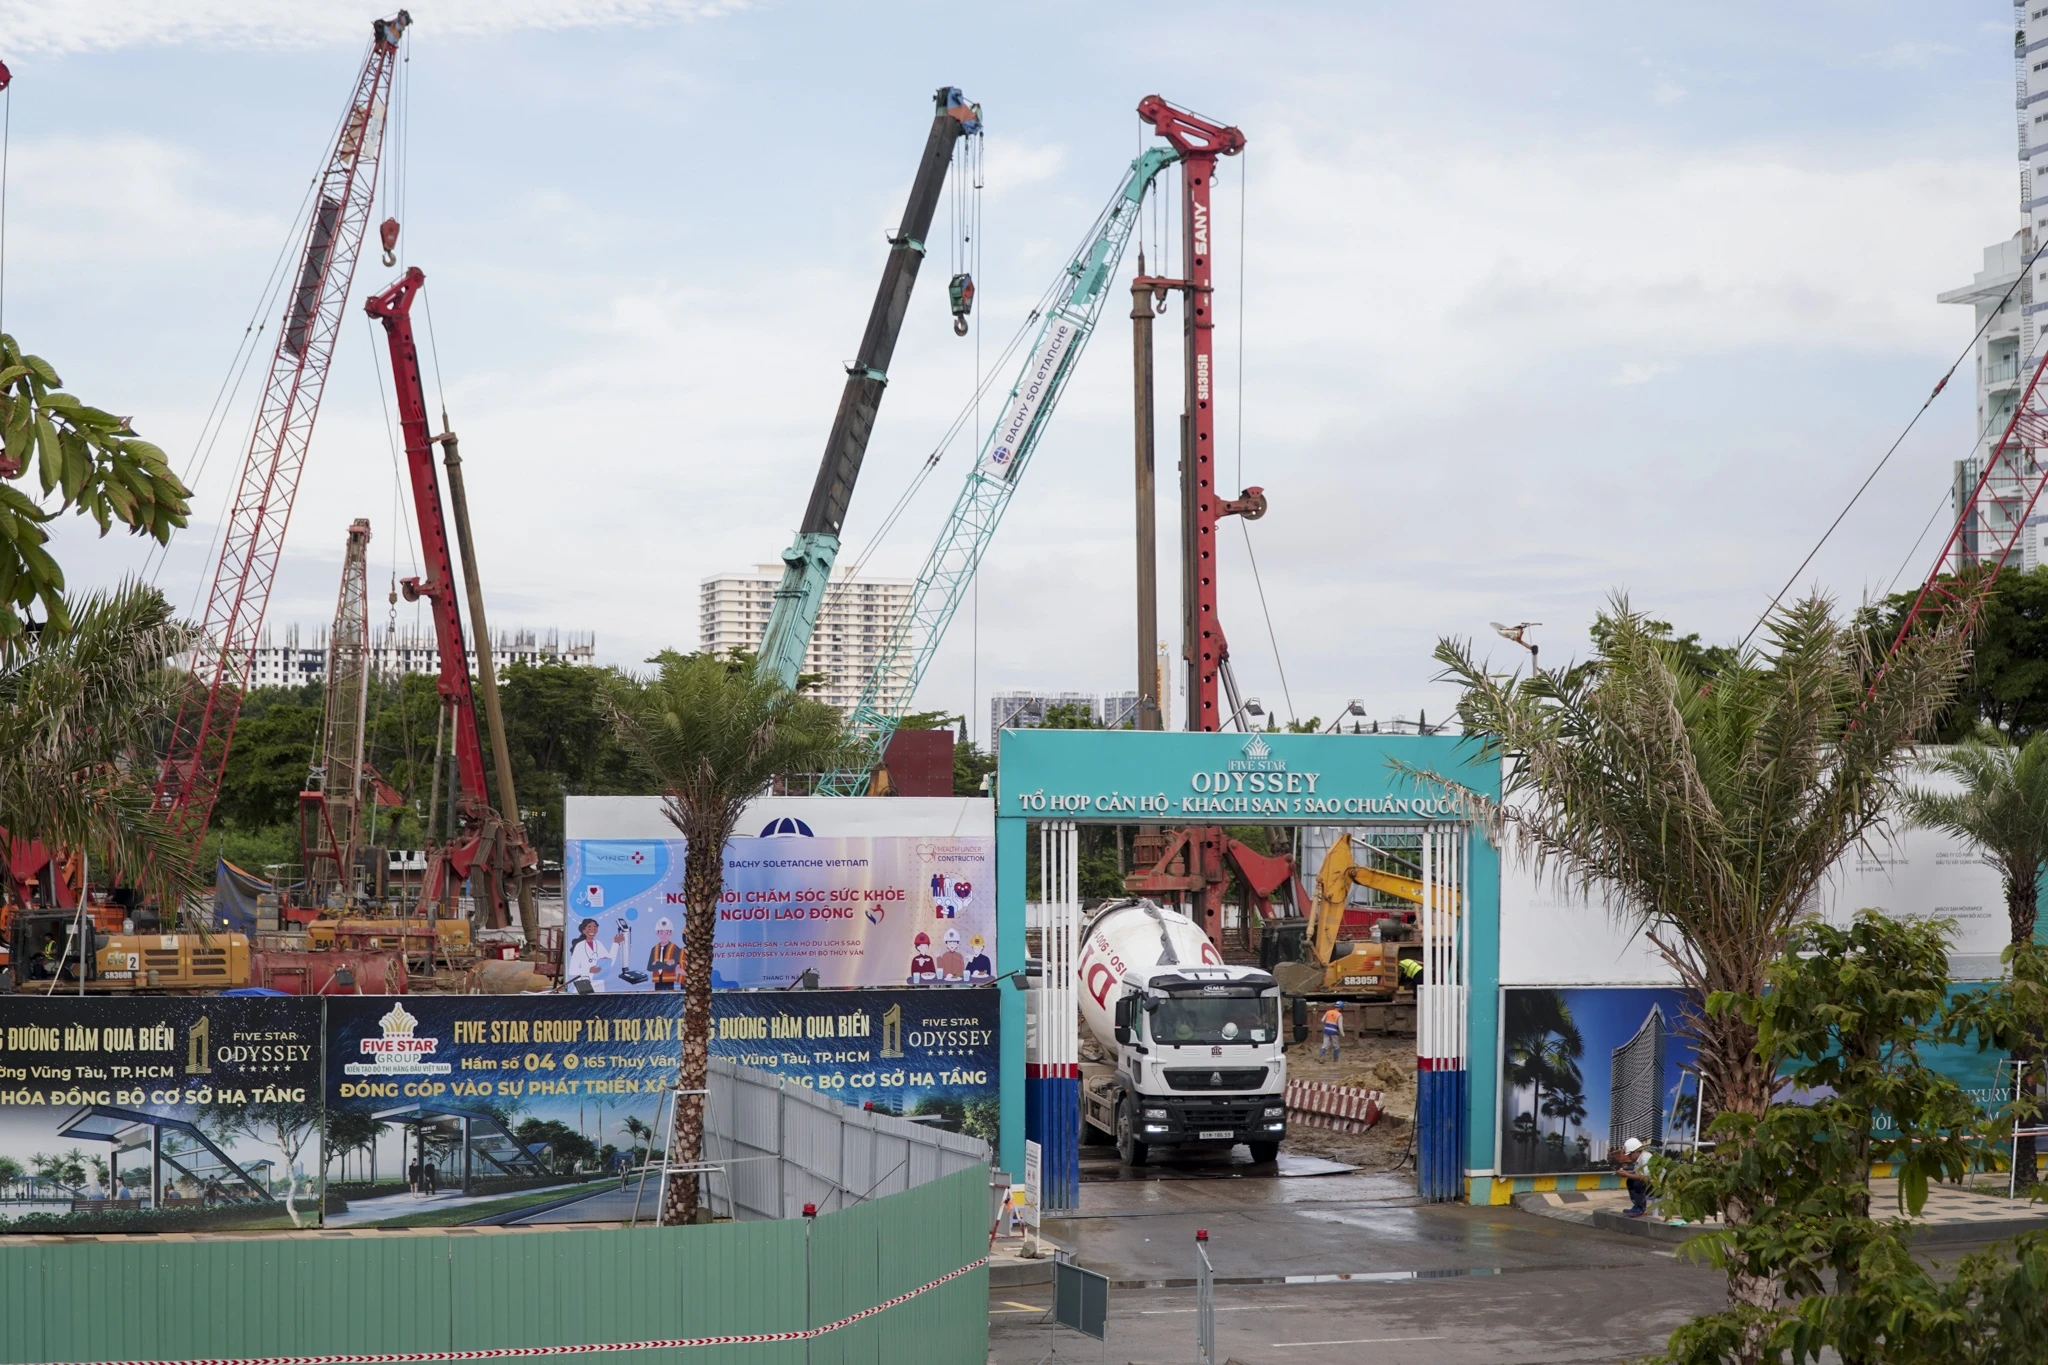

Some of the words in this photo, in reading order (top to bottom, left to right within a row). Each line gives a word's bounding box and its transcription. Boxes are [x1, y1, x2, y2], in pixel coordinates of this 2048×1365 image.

[1195, 202, 1208, 255] SANY
[1005, 403, 1029, 444] BACHY
[1230, 760, 1255, 770] FIVE
[1258, 760, 1286, 771] STAR
[1191, 772, 1320, 793] ODYSSEY
[1019, 788, 1047, 811] TỔ
[1050, 794, 1091, 815] HỢP
[1095, 791, 1136, 811] CĂN
[1139, 792, 1169, 816] HỘ
[1182, 791, 1248, 812] KHÁCH
[1251, 798, 1288, 816] SẠN
[1293, 798, 1301, 812] 5
[1305, 798, 1341, 813] SAO
[1344, 793, 1409, 814] CHUẨN
[729, 860, 760, 868] BACHY
[750, 888, 790, 903] CHĂM
[795, 887, 825, 902] SÓC
[830, 887, 859, 901] SỨC
[864, 886, 905, 901] KHỎE
[721, 906, 769, 920] NGƯỜI
[774, 908, 805, 920] LAO
[809, 904, 853, 922] ĐỘNG
[738, 940, 763, 948] KHÁCH
[764, 941, 778, 949] SẠN
[130, 957, 137, 968] 2
[1110, 956, 1128, 976] ISO
[105, 971, 133, 979] SR360R
[1344, 976, 1379, 985] SR305R
[454, 1020, 487, 1044] FIVE
[491, 1020, 528, 1043] STAR
[533, 1019, 582, 1043] GROUP
[586, 1015, 609, 1041] TÀI
[612, 1017, 641, 1045] TRỢ
[645, 1016, 673, 1041] XÂY
[719, 1012, 767, 1039] ĐƯỜNG
[771, 1010, 802, 1039] HẦM
[806, 1016, 835, 1040] QUA
[838, 1009, 870, 1038] BIỂN
[922, 1018, 948, 1027] FIVE
[950, 1017, 979, 1026] STAR
[8, 1022, 59, 1051] ĐƯỜNG
[64, 1021, 98, 1051] HẦM
[103, 1027, 134, 1053] QUA
[139, 1021, 174, 1051] BIỂN
[233, 1032, 262, 1042] FIVE
[265, 1031, 298, 1041] STAR
[908, 1030, 992, 1047] ODYSSEY
[217, 1045, 312, 1063] ODYSSEY
[362, 1040, 394, 1052] FIVE
[397, 1040, 434, 1052] STAR
[377, 1053, 420, 1063] GROUP
[461, 1054, 497, 1070] Hầm
[501, 1053, 520, 1070] số
[523, 1053, 556, 1071] 04
[583, 1055, 606, 1068] 165
[741, 1053, 778, 1067] Vũng
[781, 1052, 810, 1066] Tàu,
[814, 1051, 870, 1064] TP.HCM
[30, 1065, 71, 1081] Vũng
[75, 1066, 108, 1080] Tàu,
[111, 1065, 174, 1079] TP.HCM
[346, 1063, 360, 1072] KIẾN
[361, 1065, 372, 1074] TẠO
[382, 1065, 391, 1074] THỊ
[392, 1064, 409, 1072] HÀNG
[422, 1064, 435, 1074] VIỆT
[339, 1080, 399, 1099] ĐÓNG
[404, 1080, 446, 1098] GÓP
[451, 1078, 493, 1097] VÀO
[497, 1078, 524, 1100] SỰ
[528, 1077, 578, 1096] PHÁT
[584, 1074, 639, 1094] TRIỂN
[818, 1071, 845, 1091] BỘ
[849, 1071, 876, 1088] CƠ
[880, 1067, 905, 1087] SỞ
[909, 1071, 936, 1090] HẠ
[939, 1067, 987, 1086] TẦNG
[1, 1086, 46, 1106] HÓA
[50, 1085, 111, 1106] ĐỒNG
[116, 1086, 146, 1109] BỘ
[151, 1088, 180, 1105] CƠ
[185, 1087, 213, 1105] SỞ
[218, 1089, 245, 1108] HẠ
[252, 1085, 306, 1104] TẦNG
[1961, 1088, 2011, 1103] UXURY
